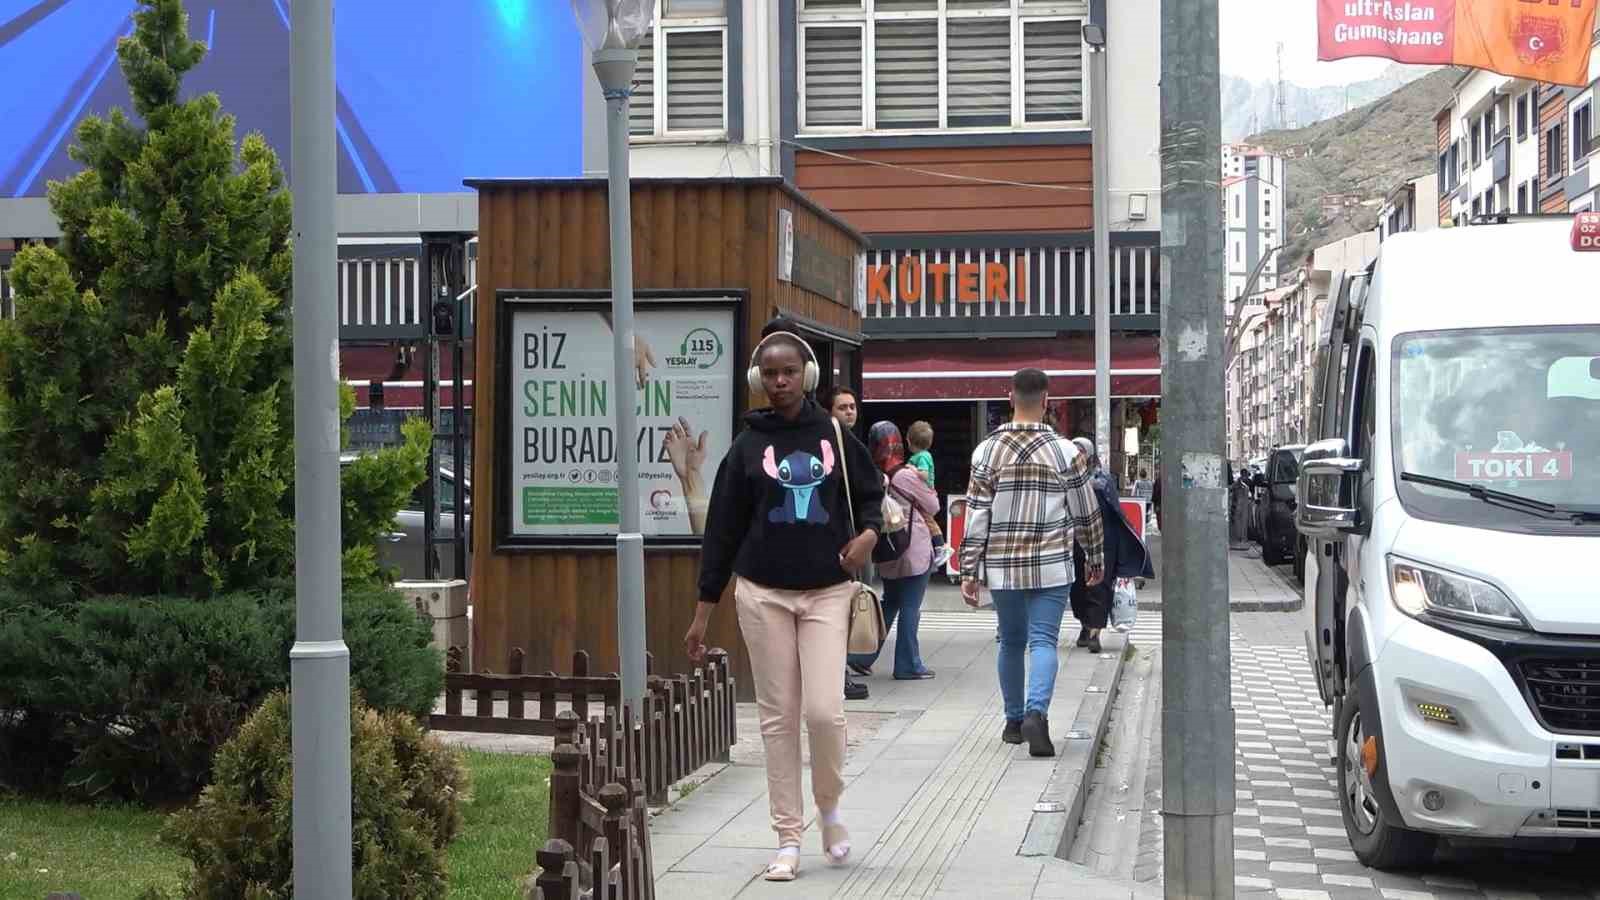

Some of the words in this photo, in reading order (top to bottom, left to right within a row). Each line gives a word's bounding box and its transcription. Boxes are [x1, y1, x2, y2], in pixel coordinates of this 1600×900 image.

[523, 325, 567, 369] BİZ
[691, 339, 714, 352] 115
[523, 373, 607, 417] SENİN
[1542, 458, 1559, 477] 4
